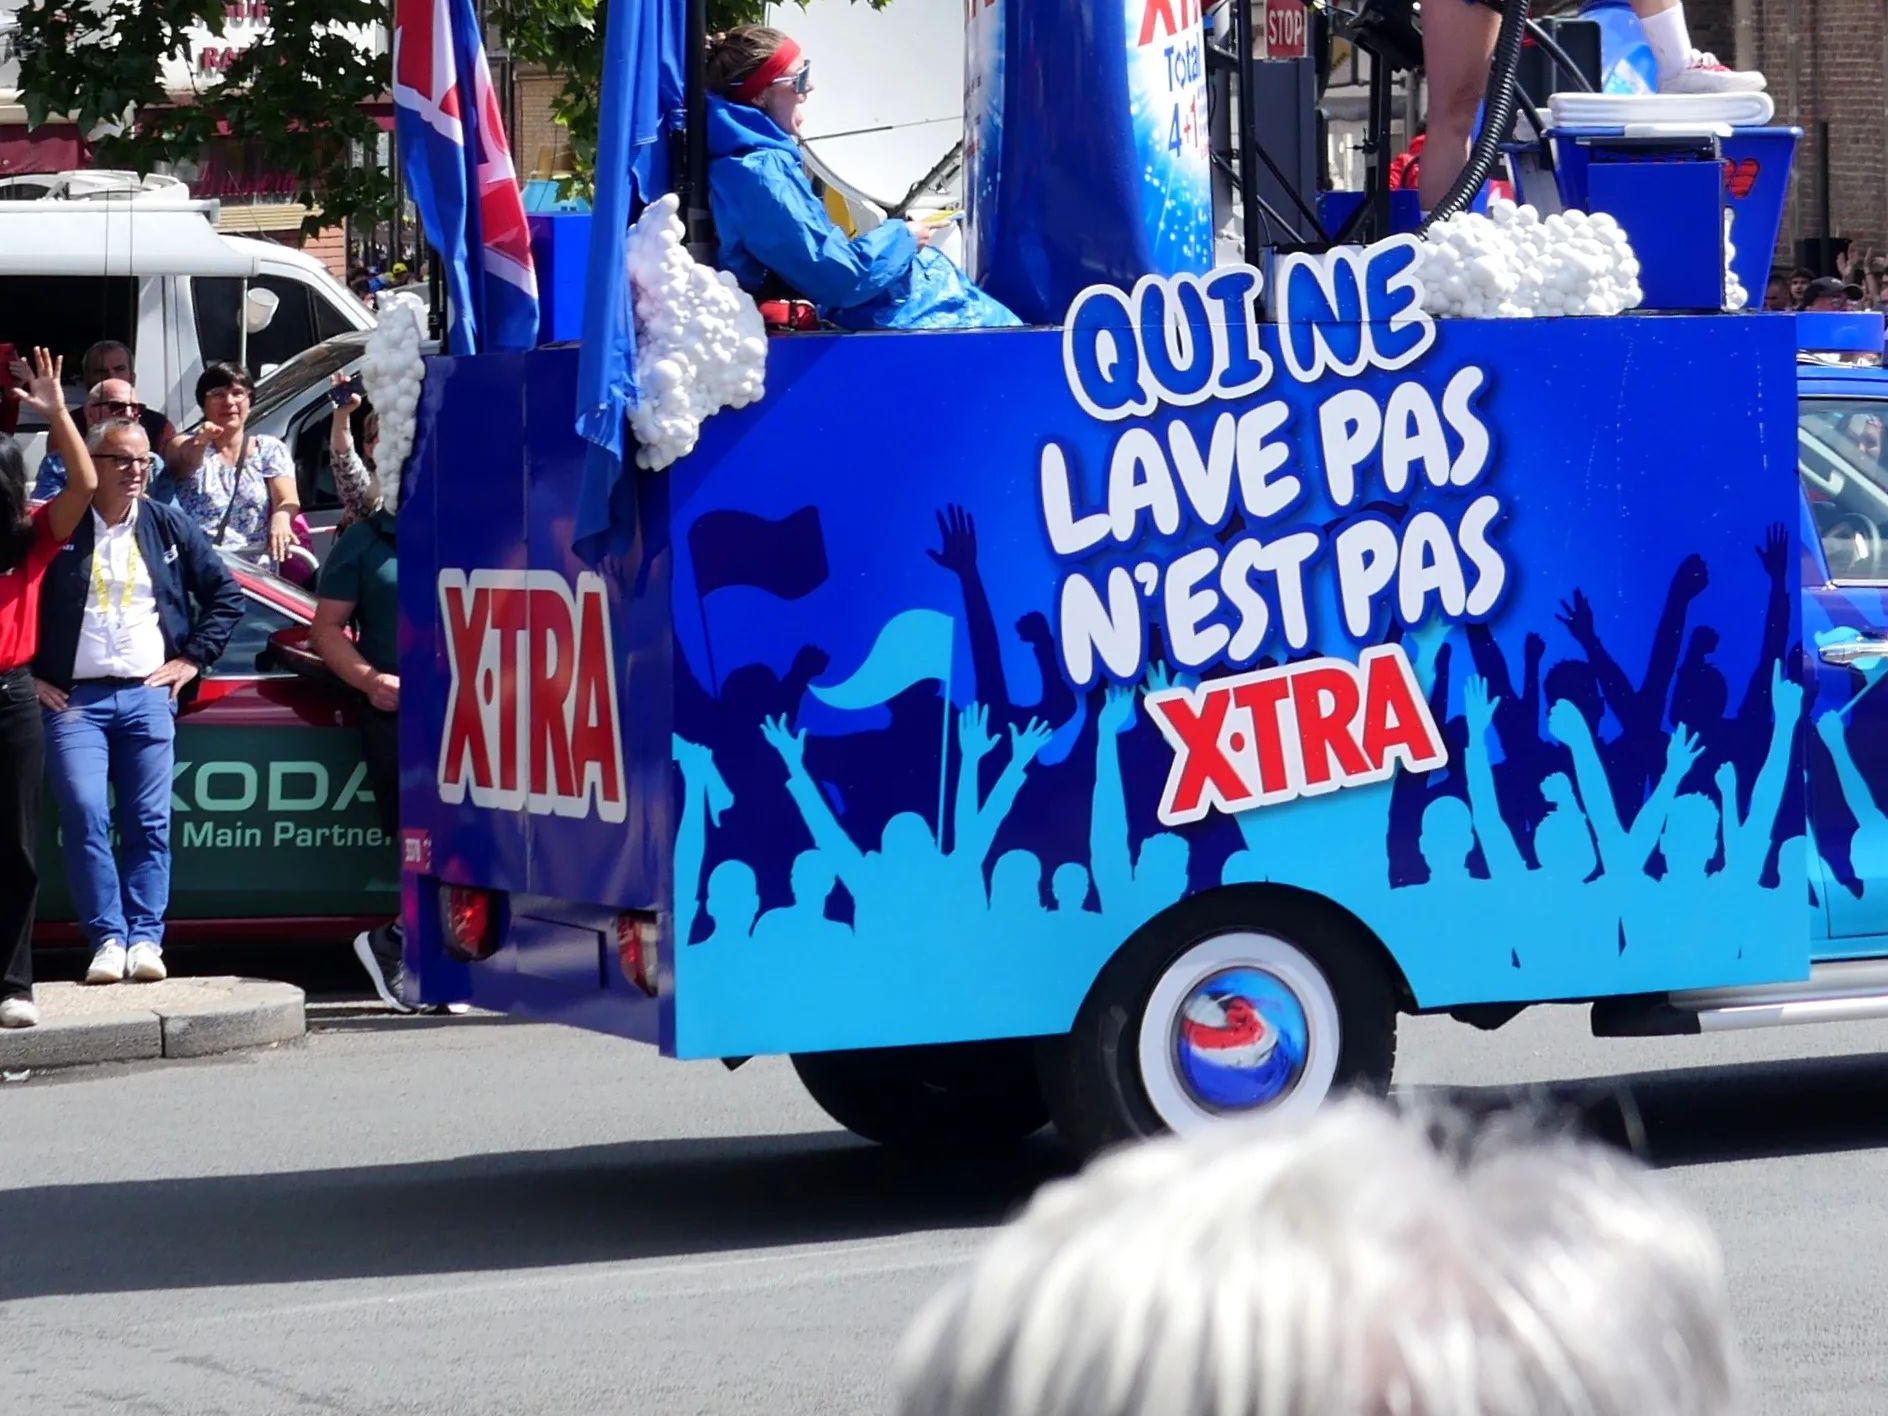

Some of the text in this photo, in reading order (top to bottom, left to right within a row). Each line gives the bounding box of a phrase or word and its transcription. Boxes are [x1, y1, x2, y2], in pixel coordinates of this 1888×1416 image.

[1268, 9, 1303, 46] STOP
[1070, 241, 1429, 412] QUI NE
[1041, 366, 1490, 555] LAVE PAS
[1060, 495, 1506, 685] N'EST PAS
[182, 821, 392, 848] Main Partne
